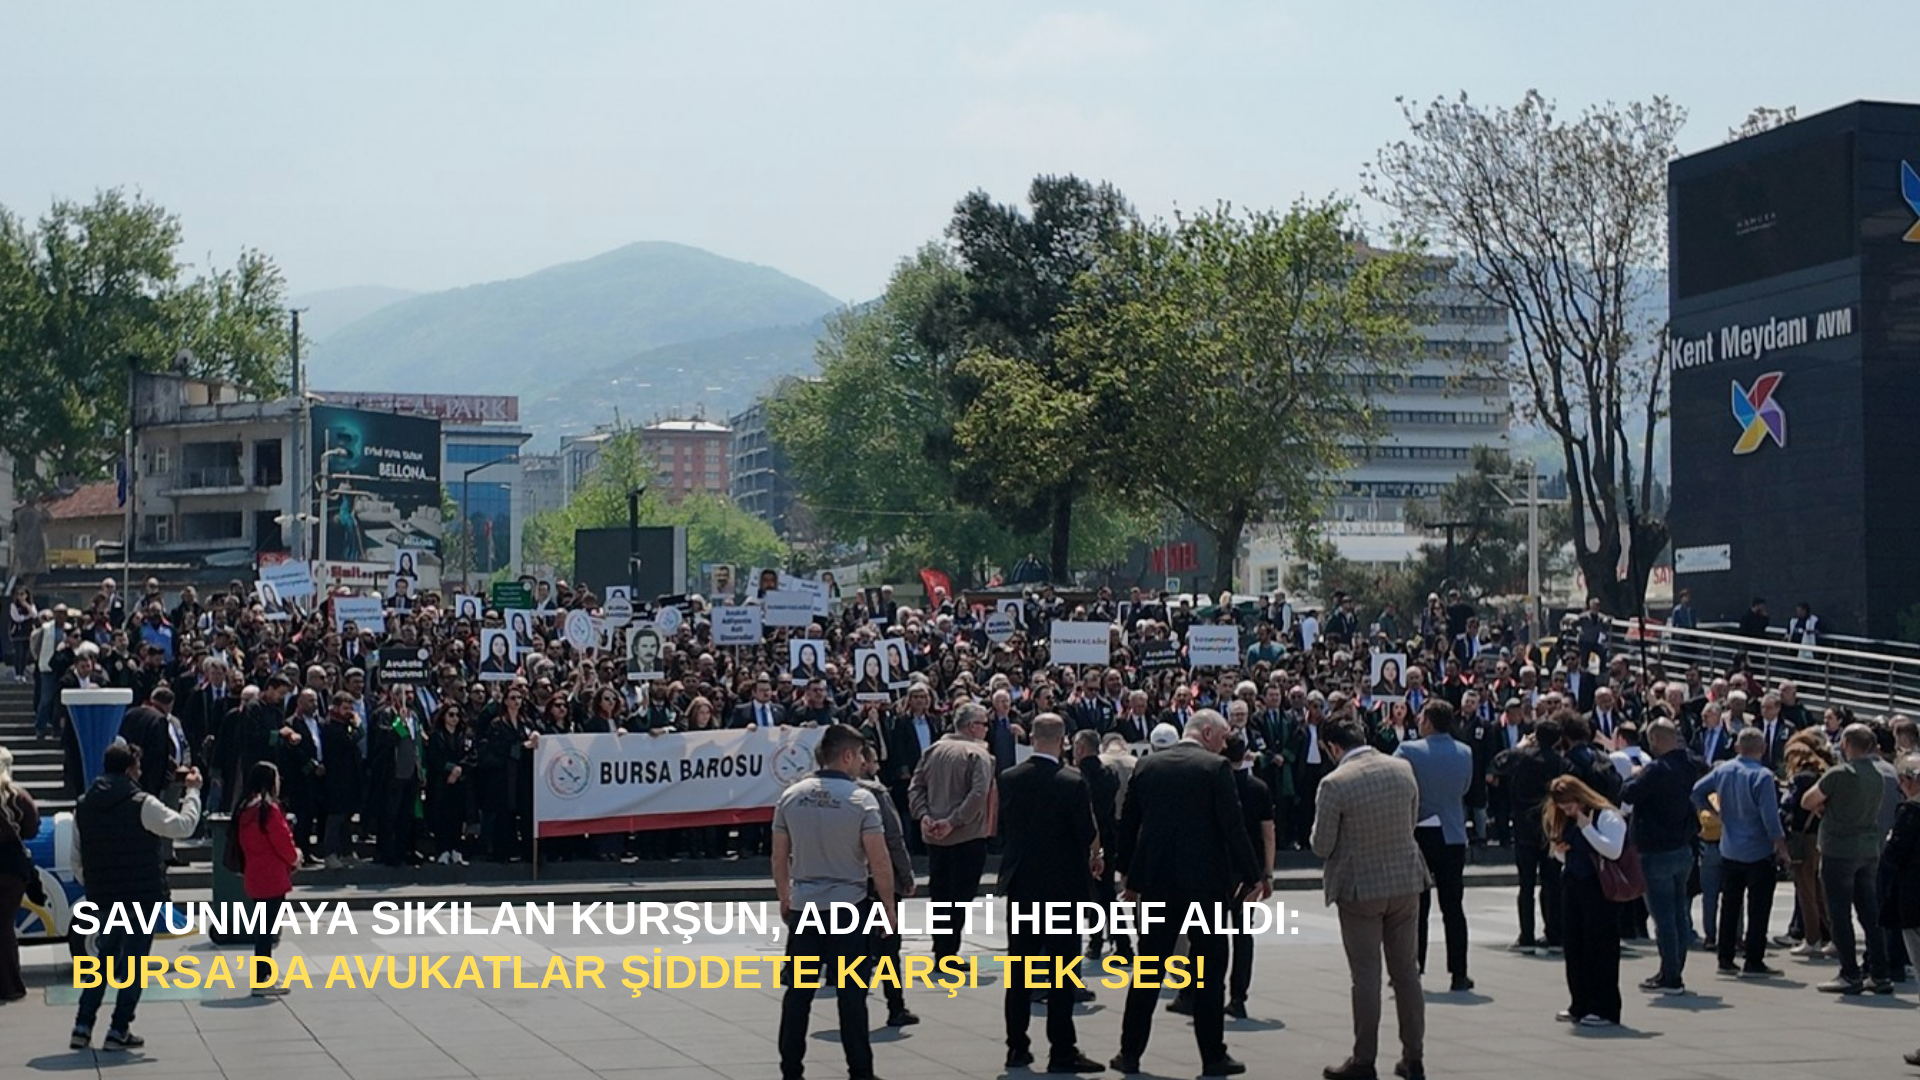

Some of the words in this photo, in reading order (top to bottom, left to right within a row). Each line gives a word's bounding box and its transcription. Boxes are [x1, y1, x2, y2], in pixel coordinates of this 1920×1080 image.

[1671, 331, 1714, 370] Kent
[1721, 316, 1808, 360] Meydanı
[1816, 307, 1852, 341] AVM
[600, 761, 672, 785] BURSA
[680, 754, 763, 782] BAROSU
